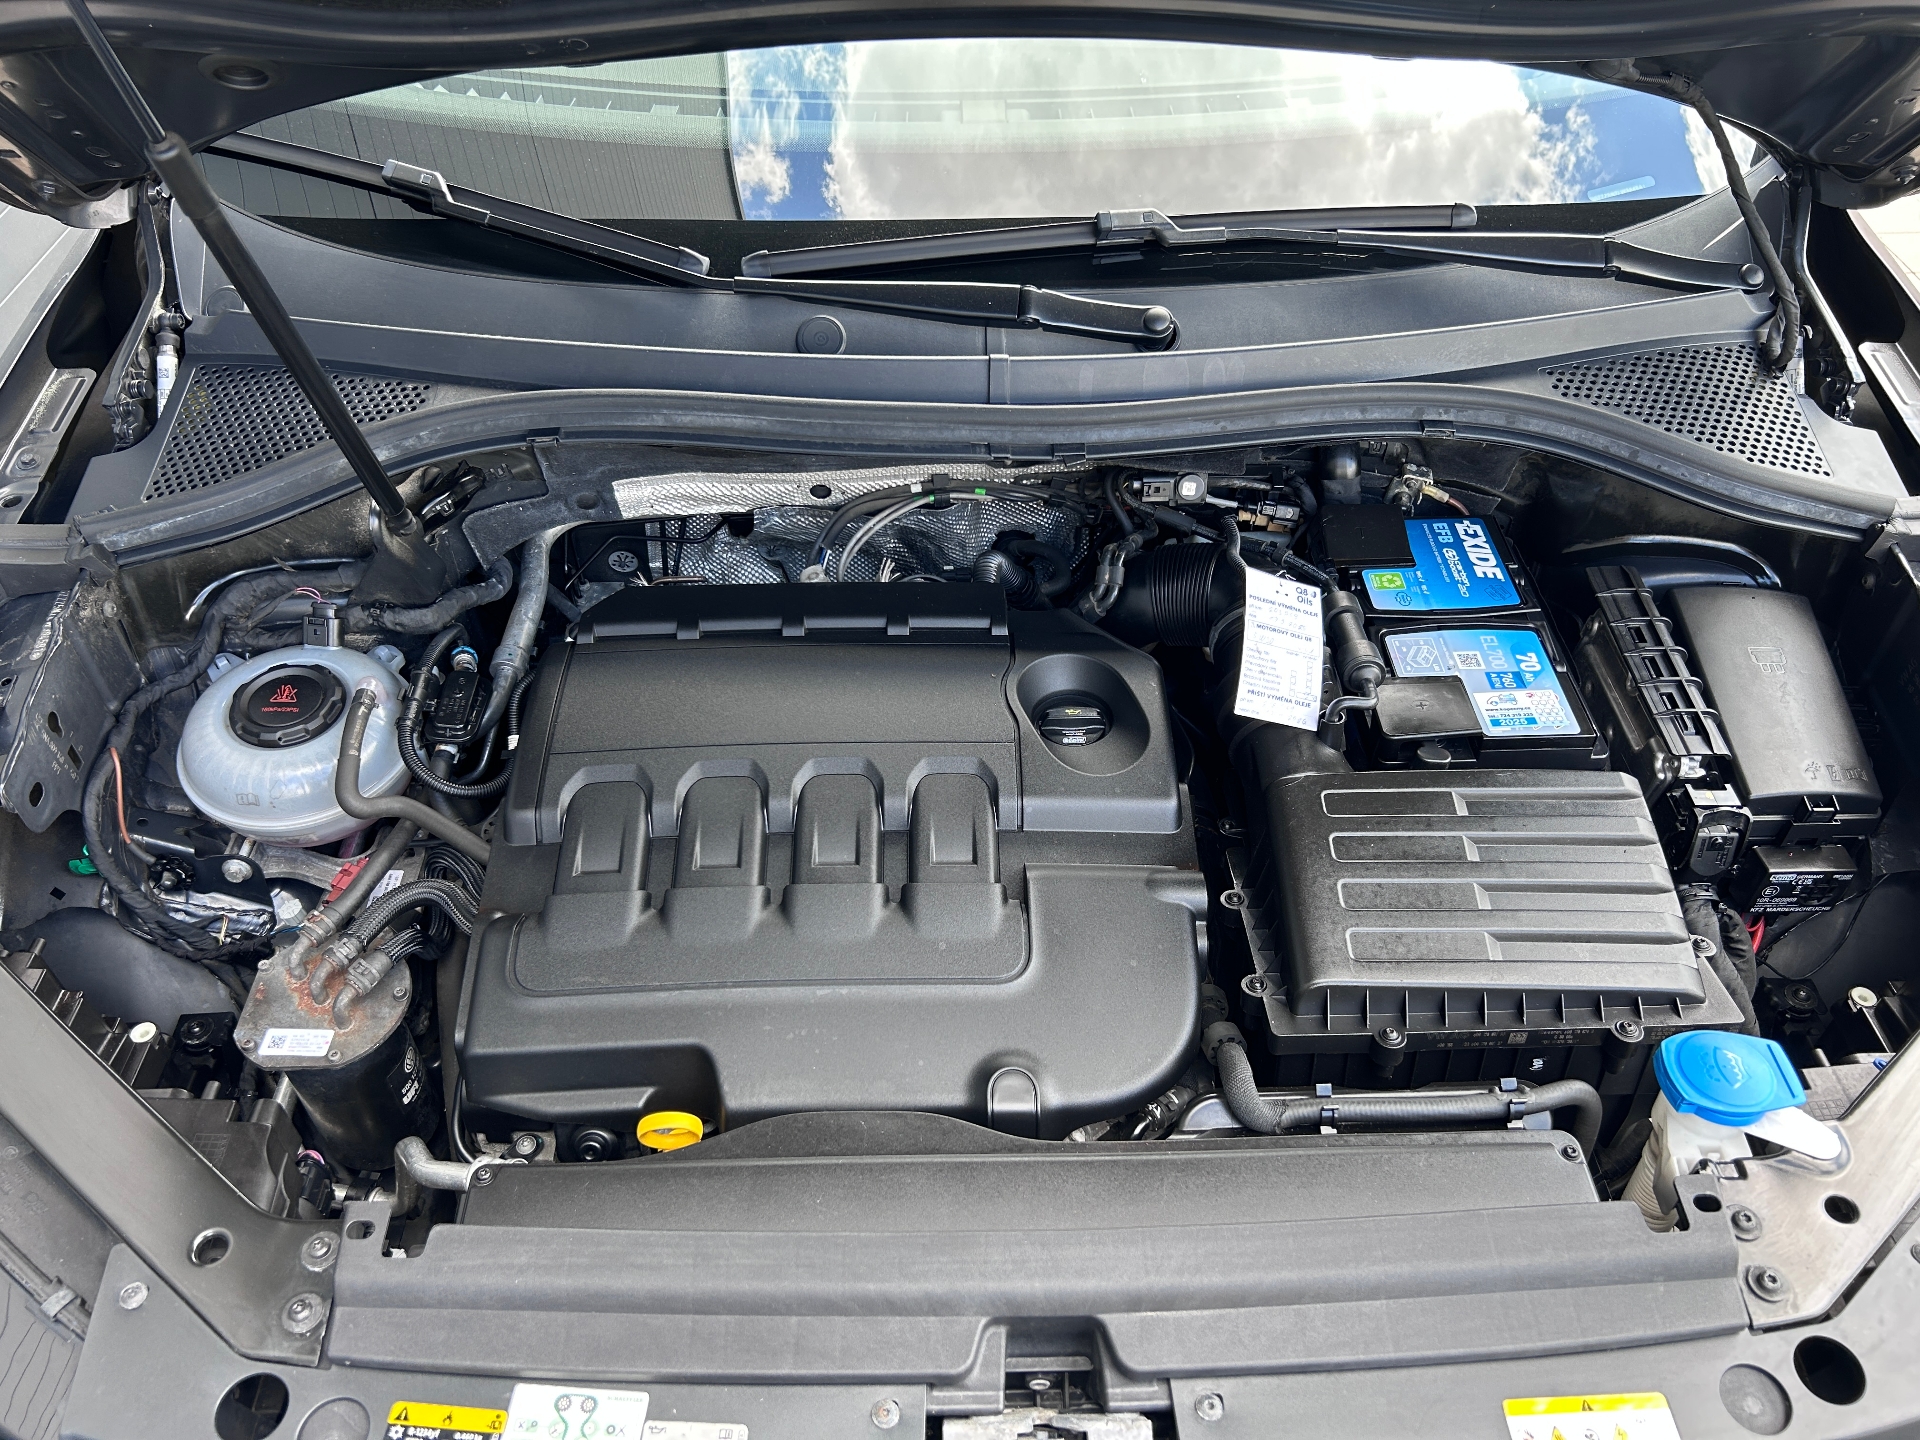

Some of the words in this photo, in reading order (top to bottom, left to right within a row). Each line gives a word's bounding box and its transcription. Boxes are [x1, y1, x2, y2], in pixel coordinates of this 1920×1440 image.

[1432, 522, 1454, 543] EFB
[1454, 520, 1505, 581] EXIDE
[1295, 586, 1309, 596] Q8
[1296, 595, 1313, 607] Oils
[1302, 609, 1319, 618] OLEJE
[1480, 635, 1508, 670] EL700
[1515, 652, 1542, 673] 70
[1499, 672, 1517, 689] 760
[1523, 671, 1537, 682] Ah
[1294, 699, 1312, 709] OLEJE
